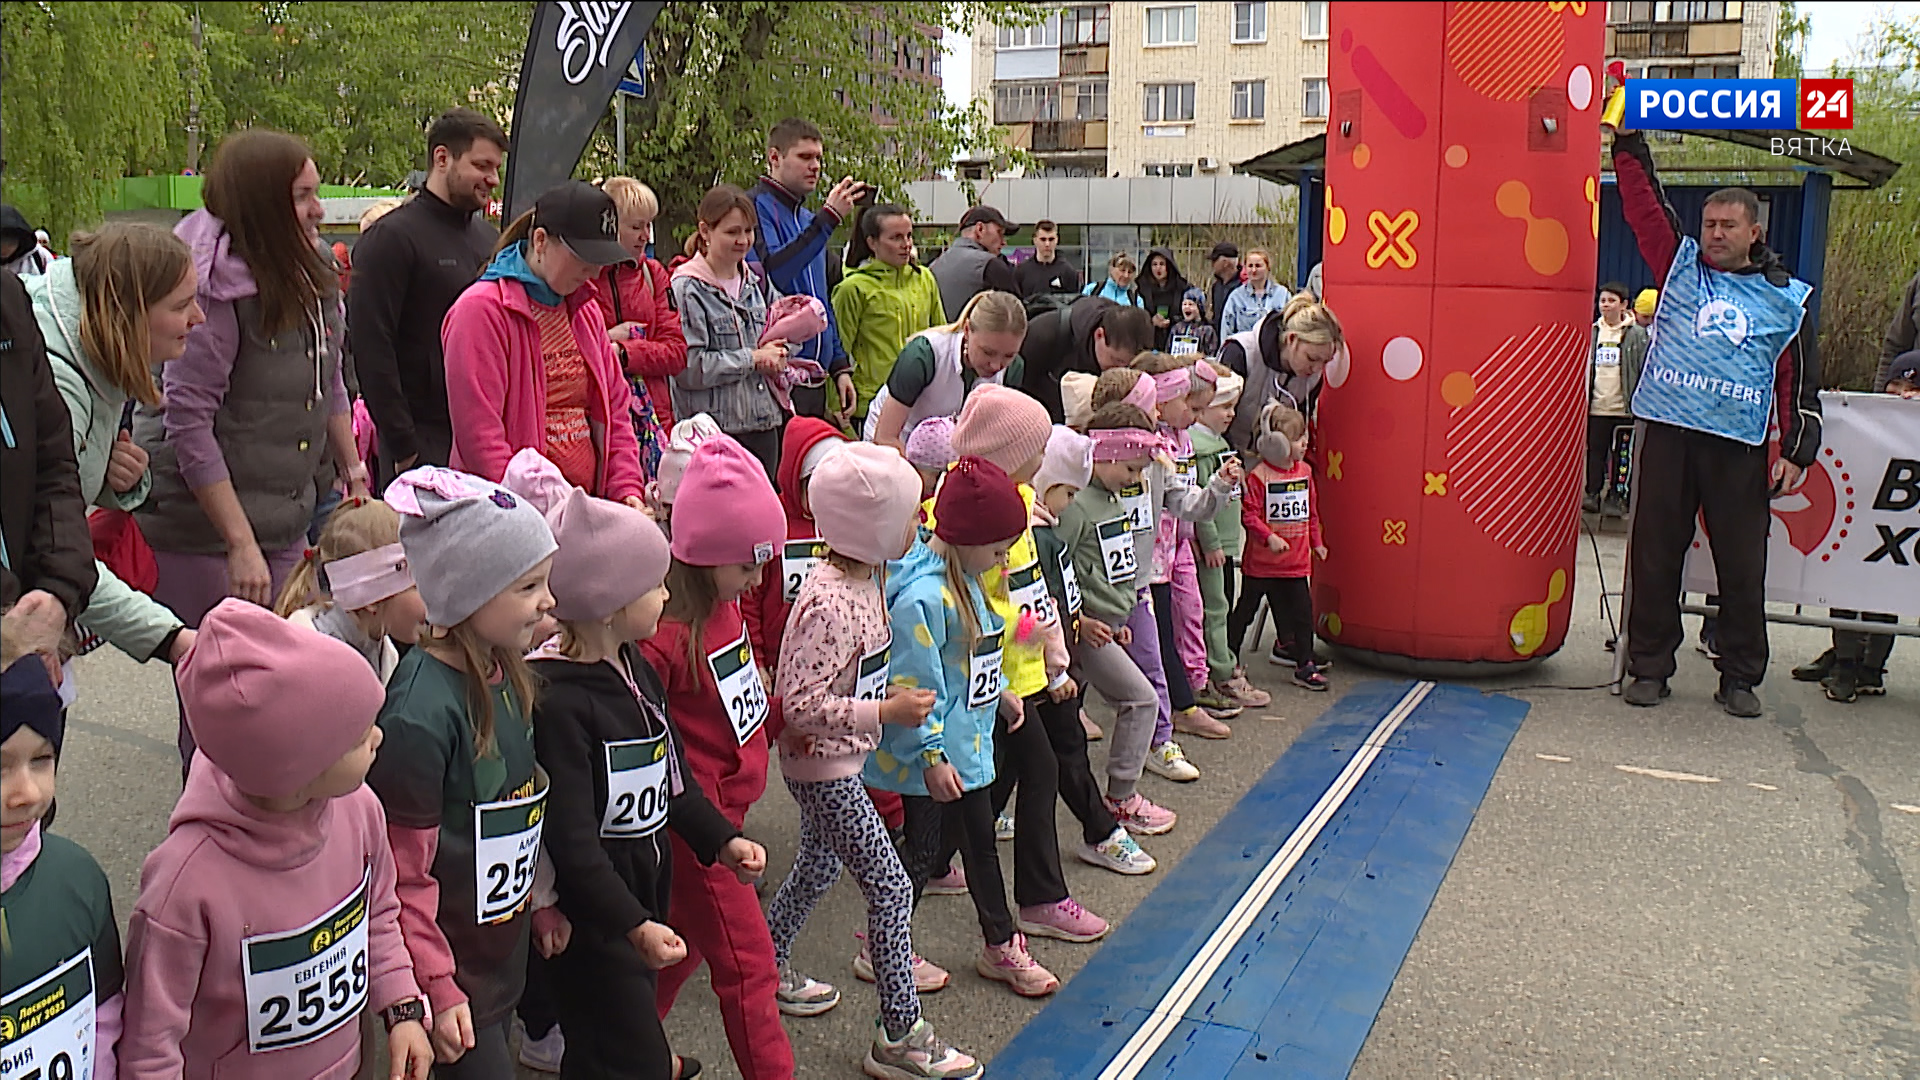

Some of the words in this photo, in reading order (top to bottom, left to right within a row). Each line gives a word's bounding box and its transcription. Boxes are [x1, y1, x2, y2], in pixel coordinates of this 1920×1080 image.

[1653, 365, 1762, 406] VOLUNTEERS
[1872, 457, 1920, 511] В
[1269, 500, 1308, 518] 2564
[294, 946, 347, 984] ЕВГЕНИЯ
[259, 949, 367, 1037] 2558
[21, 1014, 43, 1034] MAY
